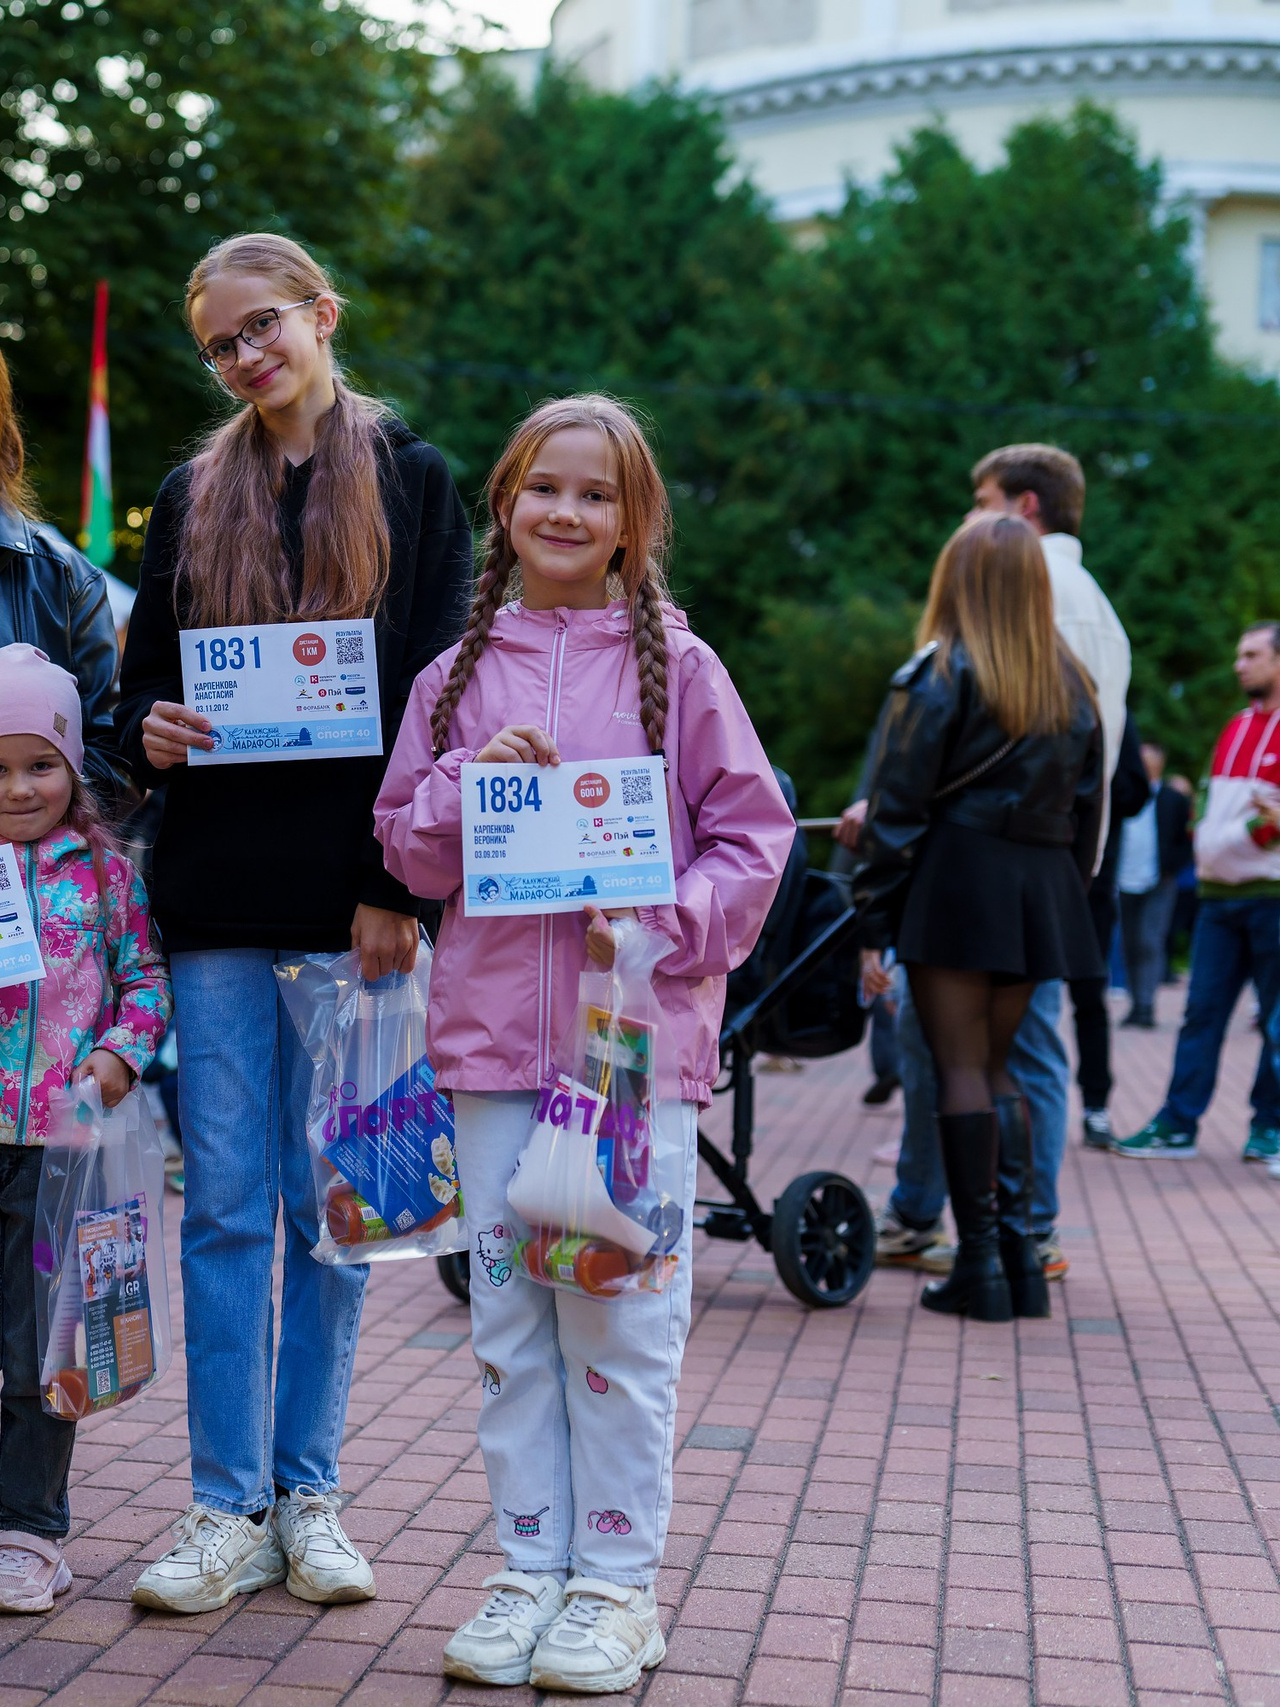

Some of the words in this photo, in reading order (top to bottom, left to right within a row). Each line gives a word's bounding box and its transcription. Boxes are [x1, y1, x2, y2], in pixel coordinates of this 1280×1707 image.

[195, 636, 261, 672] 1831
[302, 648, 306, 656] 1
[307, 647, 318, 656] КМ
[194, 681, 238, 692] КАРПЕНКОВА
[195, 691, 234, 701] АНАСТАСИЯ
[196, 704, 229, 713] 03.11.2012
[244, 727, 279, 735] КАЛУЖСКИЙ
[318, 730, 354, 740] СПОРТ
[356, 729, 370, 737] 40
[232, 739, 280, 751] МАРАФОН
[476, 776, 542, 813] 1834
[580, 788, 595, 798] 600
[596, 787, 603, 797] М
[474, 824, 515, 834] КАРПЕНКОВА
[474, 836, 507, 845] ВЕРОНИКА
[614, 832, 629, 840] Пэй
[475, 850, 507, 859] 03.09.2016
[522, 876, 560, 885] КАЛУЖСКИЙ
[603, 876, 644, 888] СПОРТ
[646, 875, 662, 884] 40
[510, 888, 562, 901] МАРАФОН
[18, 954, 31, 964] 40
[322, 1092, 438, 1143] СПОРТ
